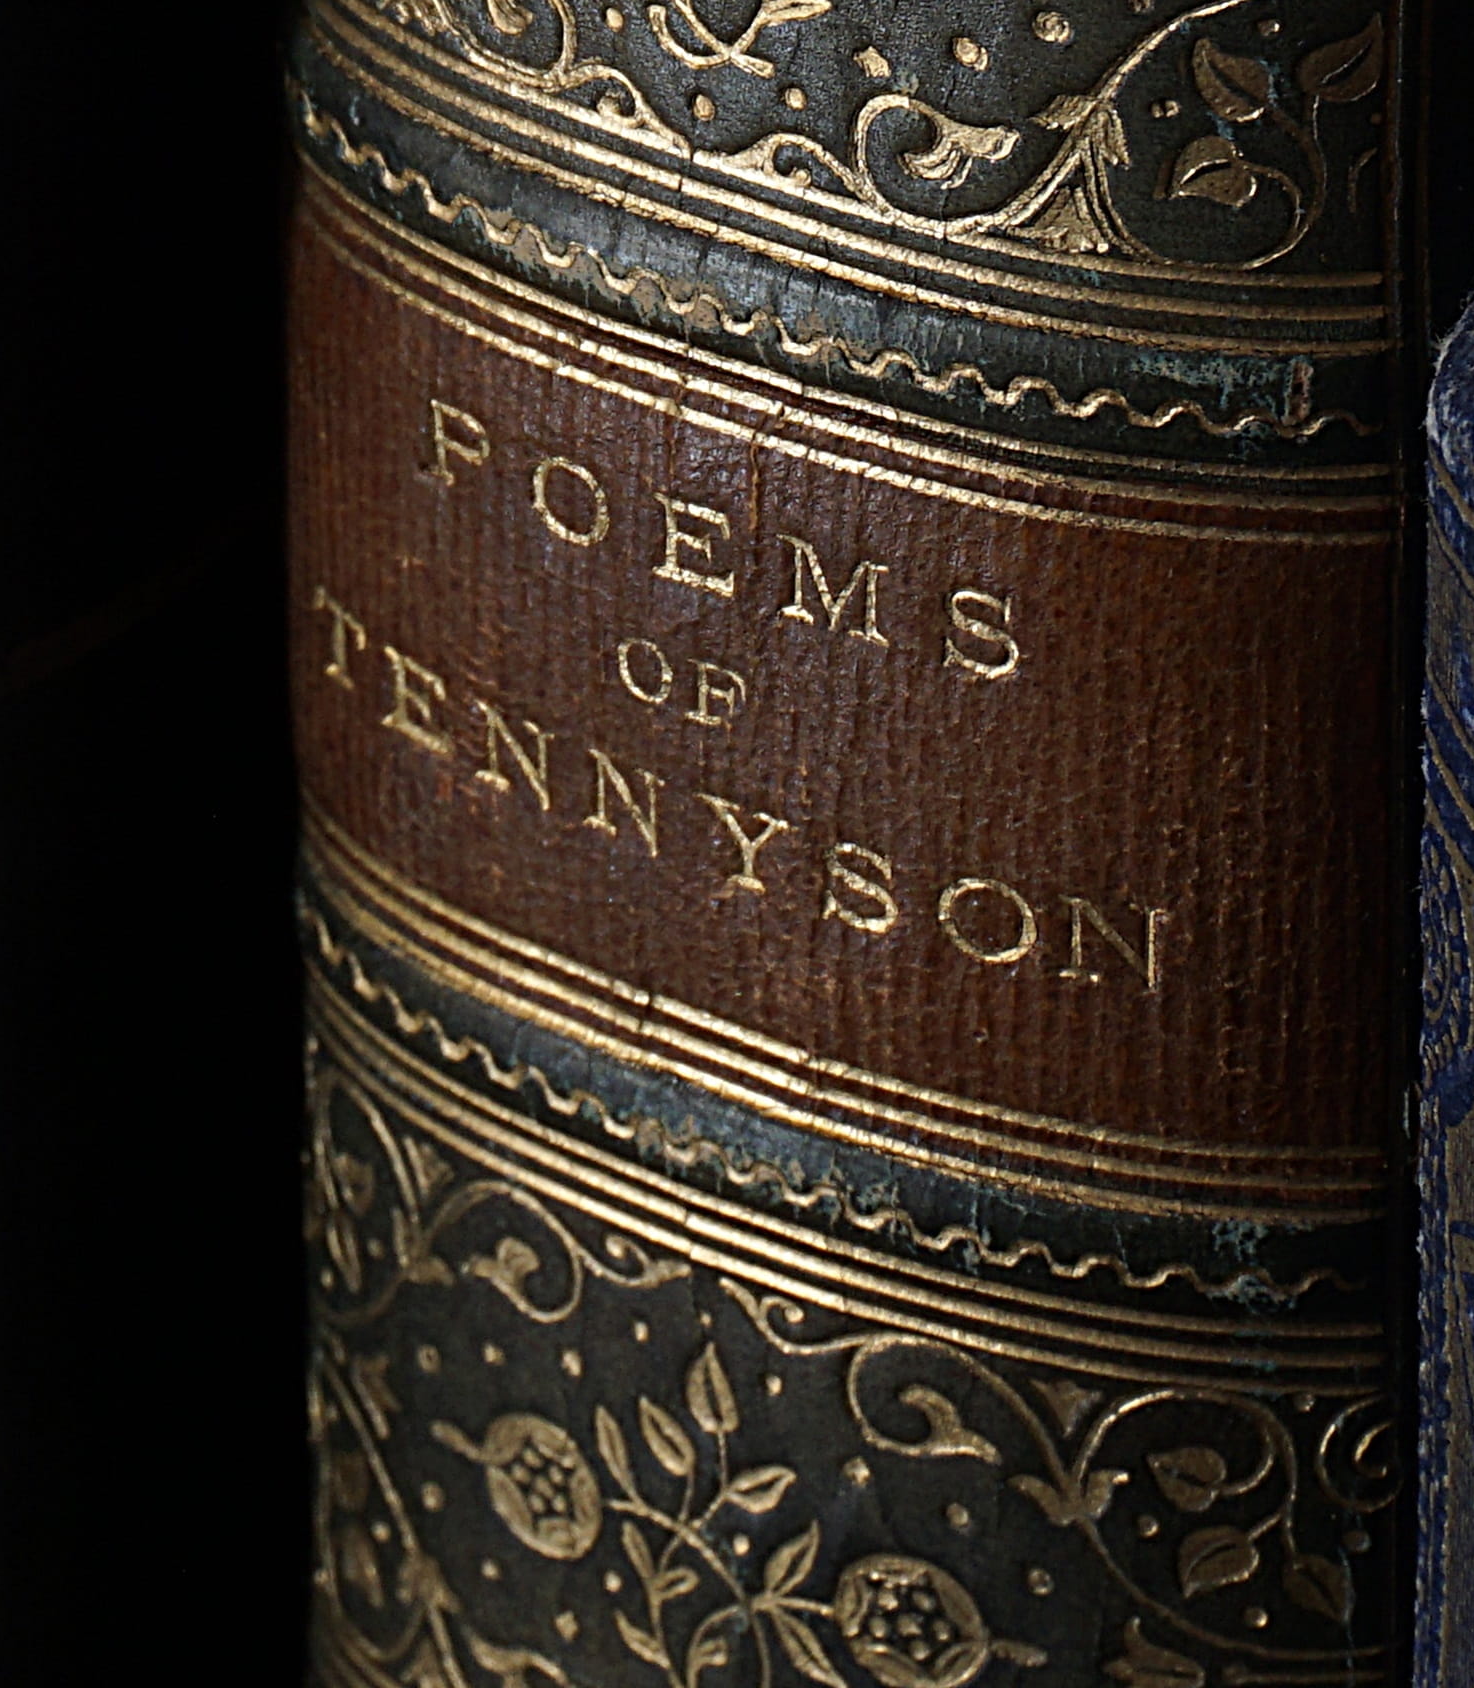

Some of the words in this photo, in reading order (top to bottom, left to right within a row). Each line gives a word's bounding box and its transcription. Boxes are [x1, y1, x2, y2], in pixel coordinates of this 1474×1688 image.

[418, 396, 1022, 682] POEMS
[615, 634, 750, 728] OF
[310, 583, 1168, 992] TENNYSON
